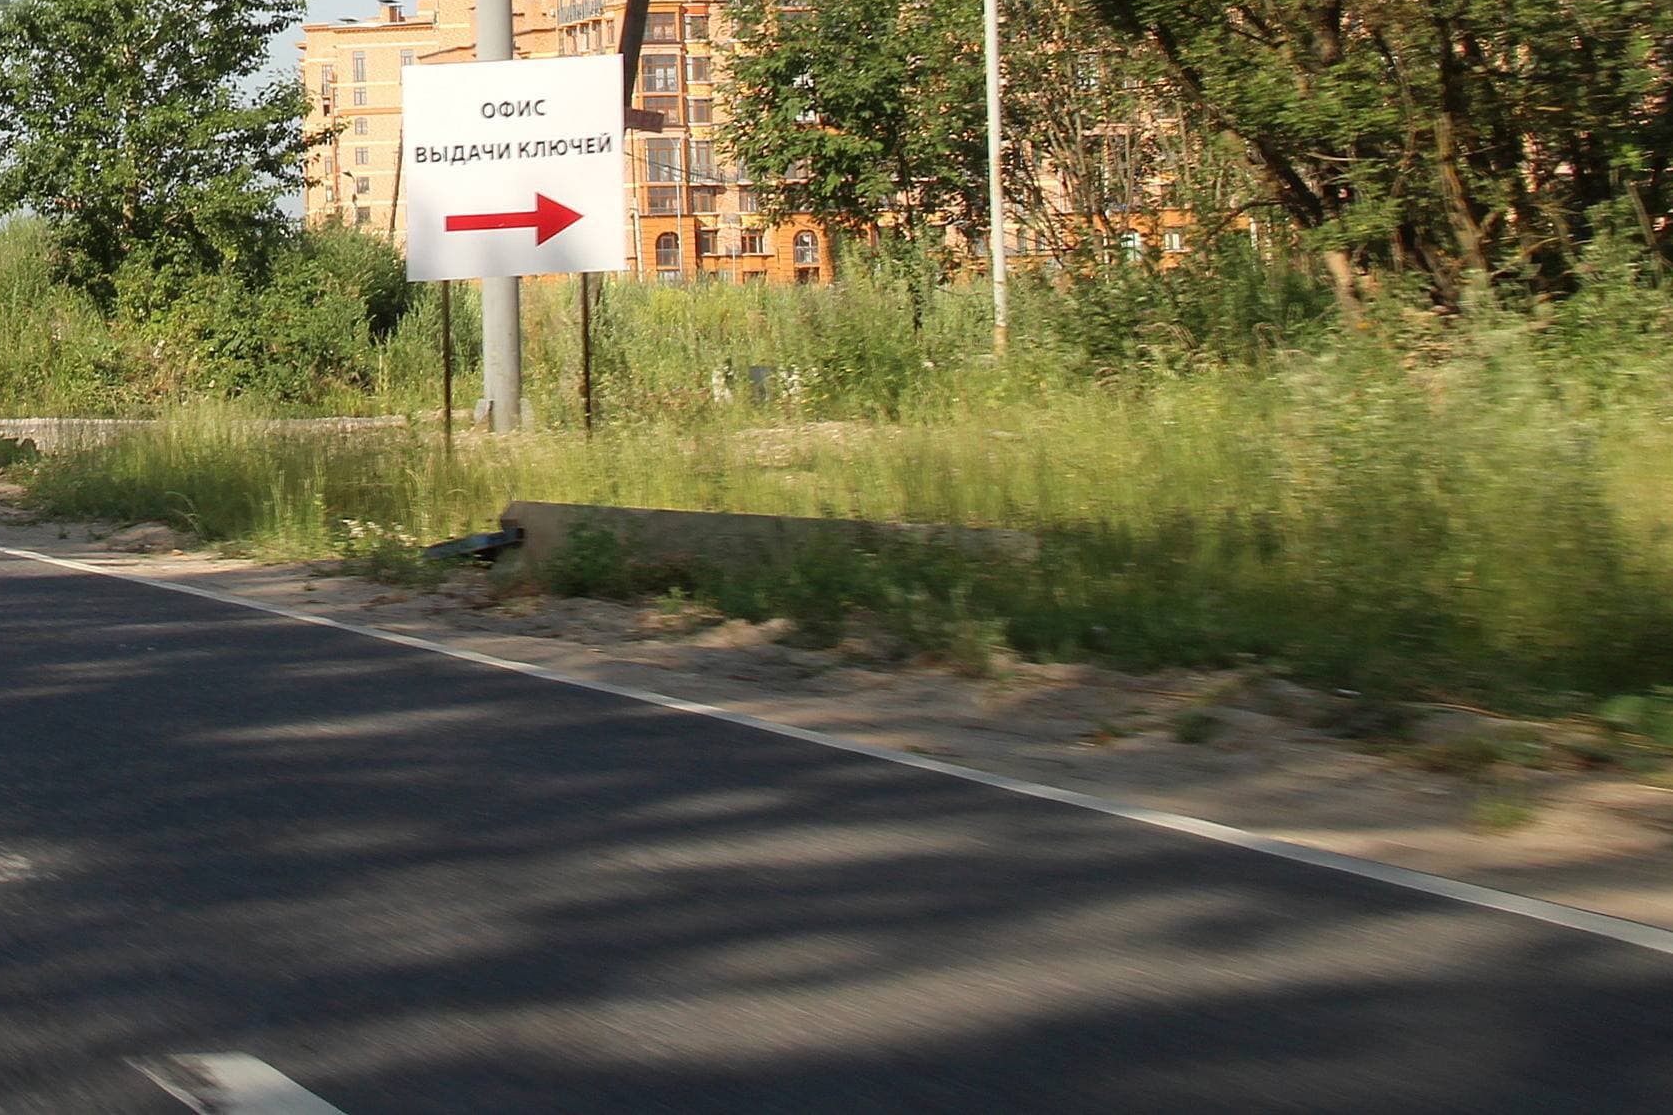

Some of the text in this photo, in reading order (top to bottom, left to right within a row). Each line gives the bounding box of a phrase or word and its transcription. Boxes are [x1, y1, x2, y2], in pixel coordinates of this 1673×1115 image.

[481, 99, 547, 118] ОФИС
[415, 132, 613, 165] ВЫДАЧИ КЛЮЧЕЙ
